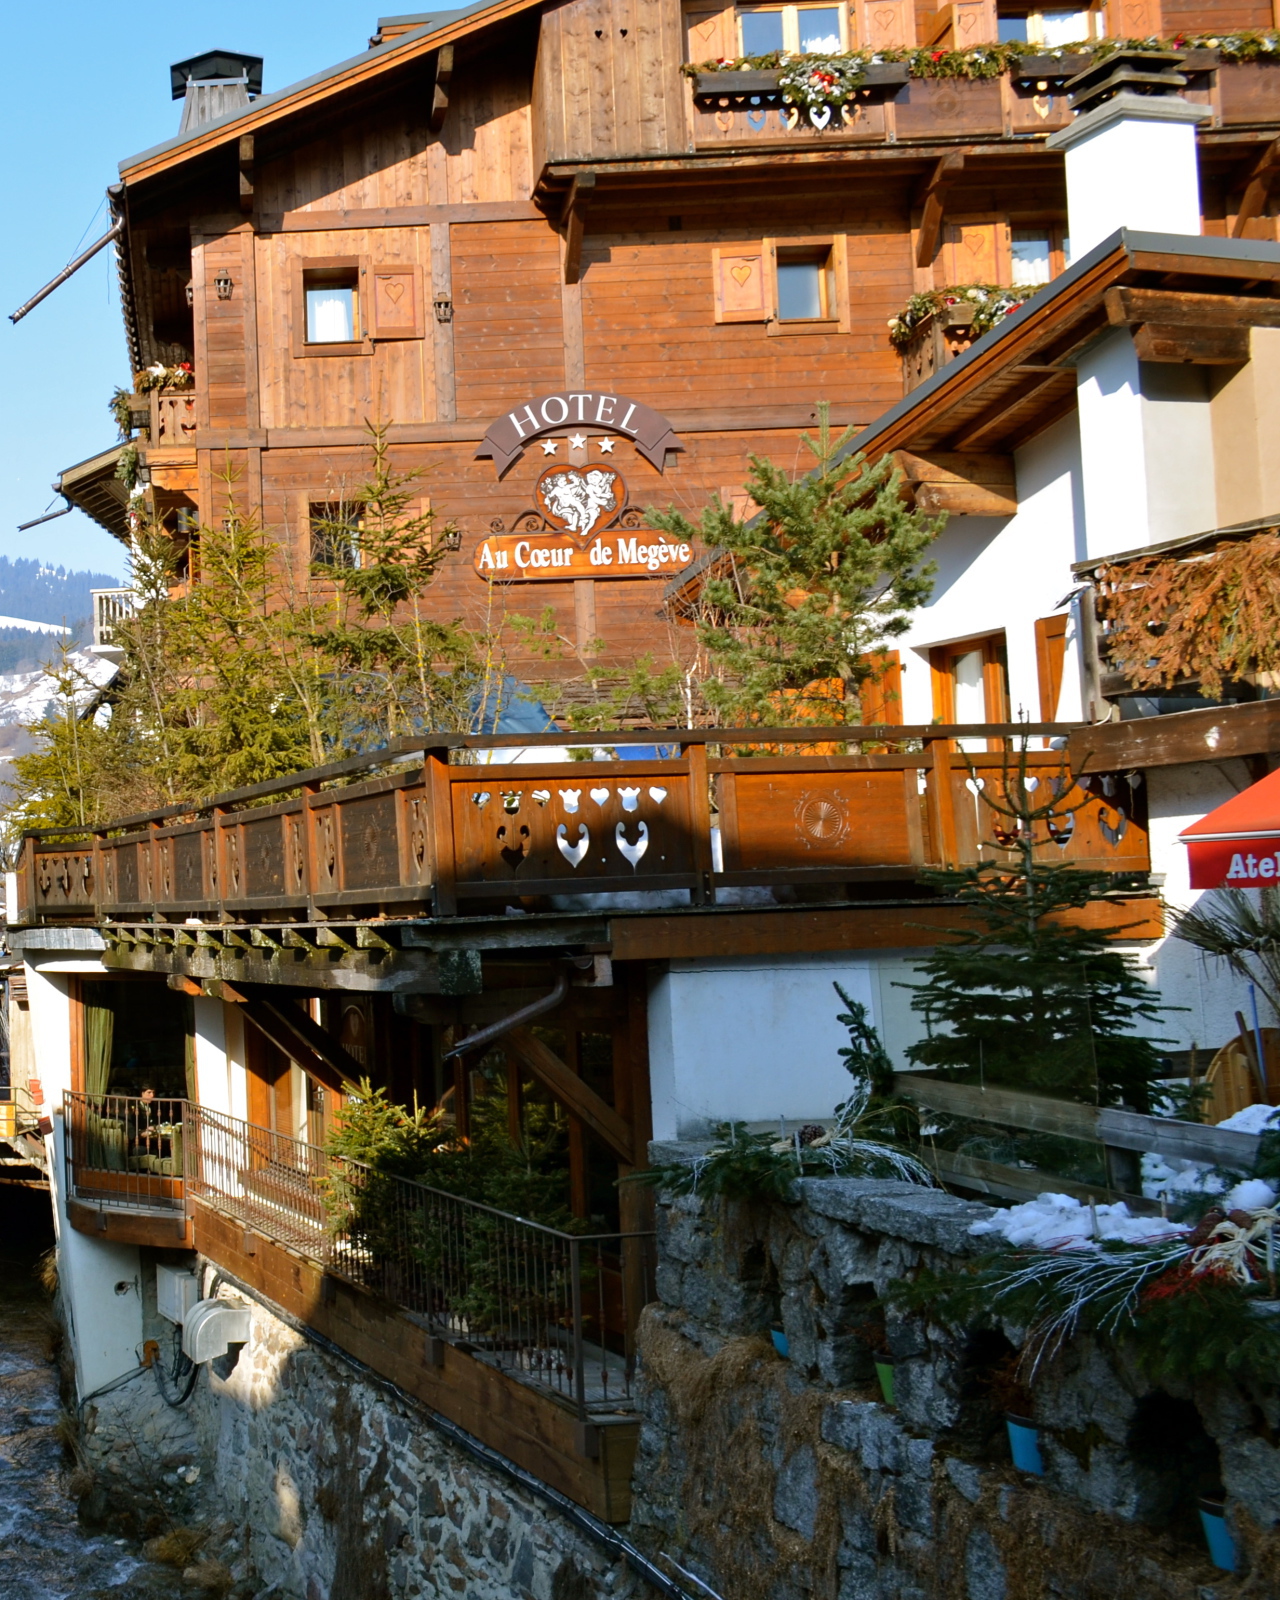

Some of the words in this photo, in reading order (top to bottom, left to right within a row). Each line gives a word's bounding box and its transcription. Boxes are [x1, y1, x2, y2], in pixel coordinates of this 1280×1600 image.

[508, 394, 639, 438] HOTEL
[479, 542, 509, 569] Au
[514, 541, 574, 568] Cœur
[589, 538, 613, 566] de
[617, 536, 690, 571] Megève
